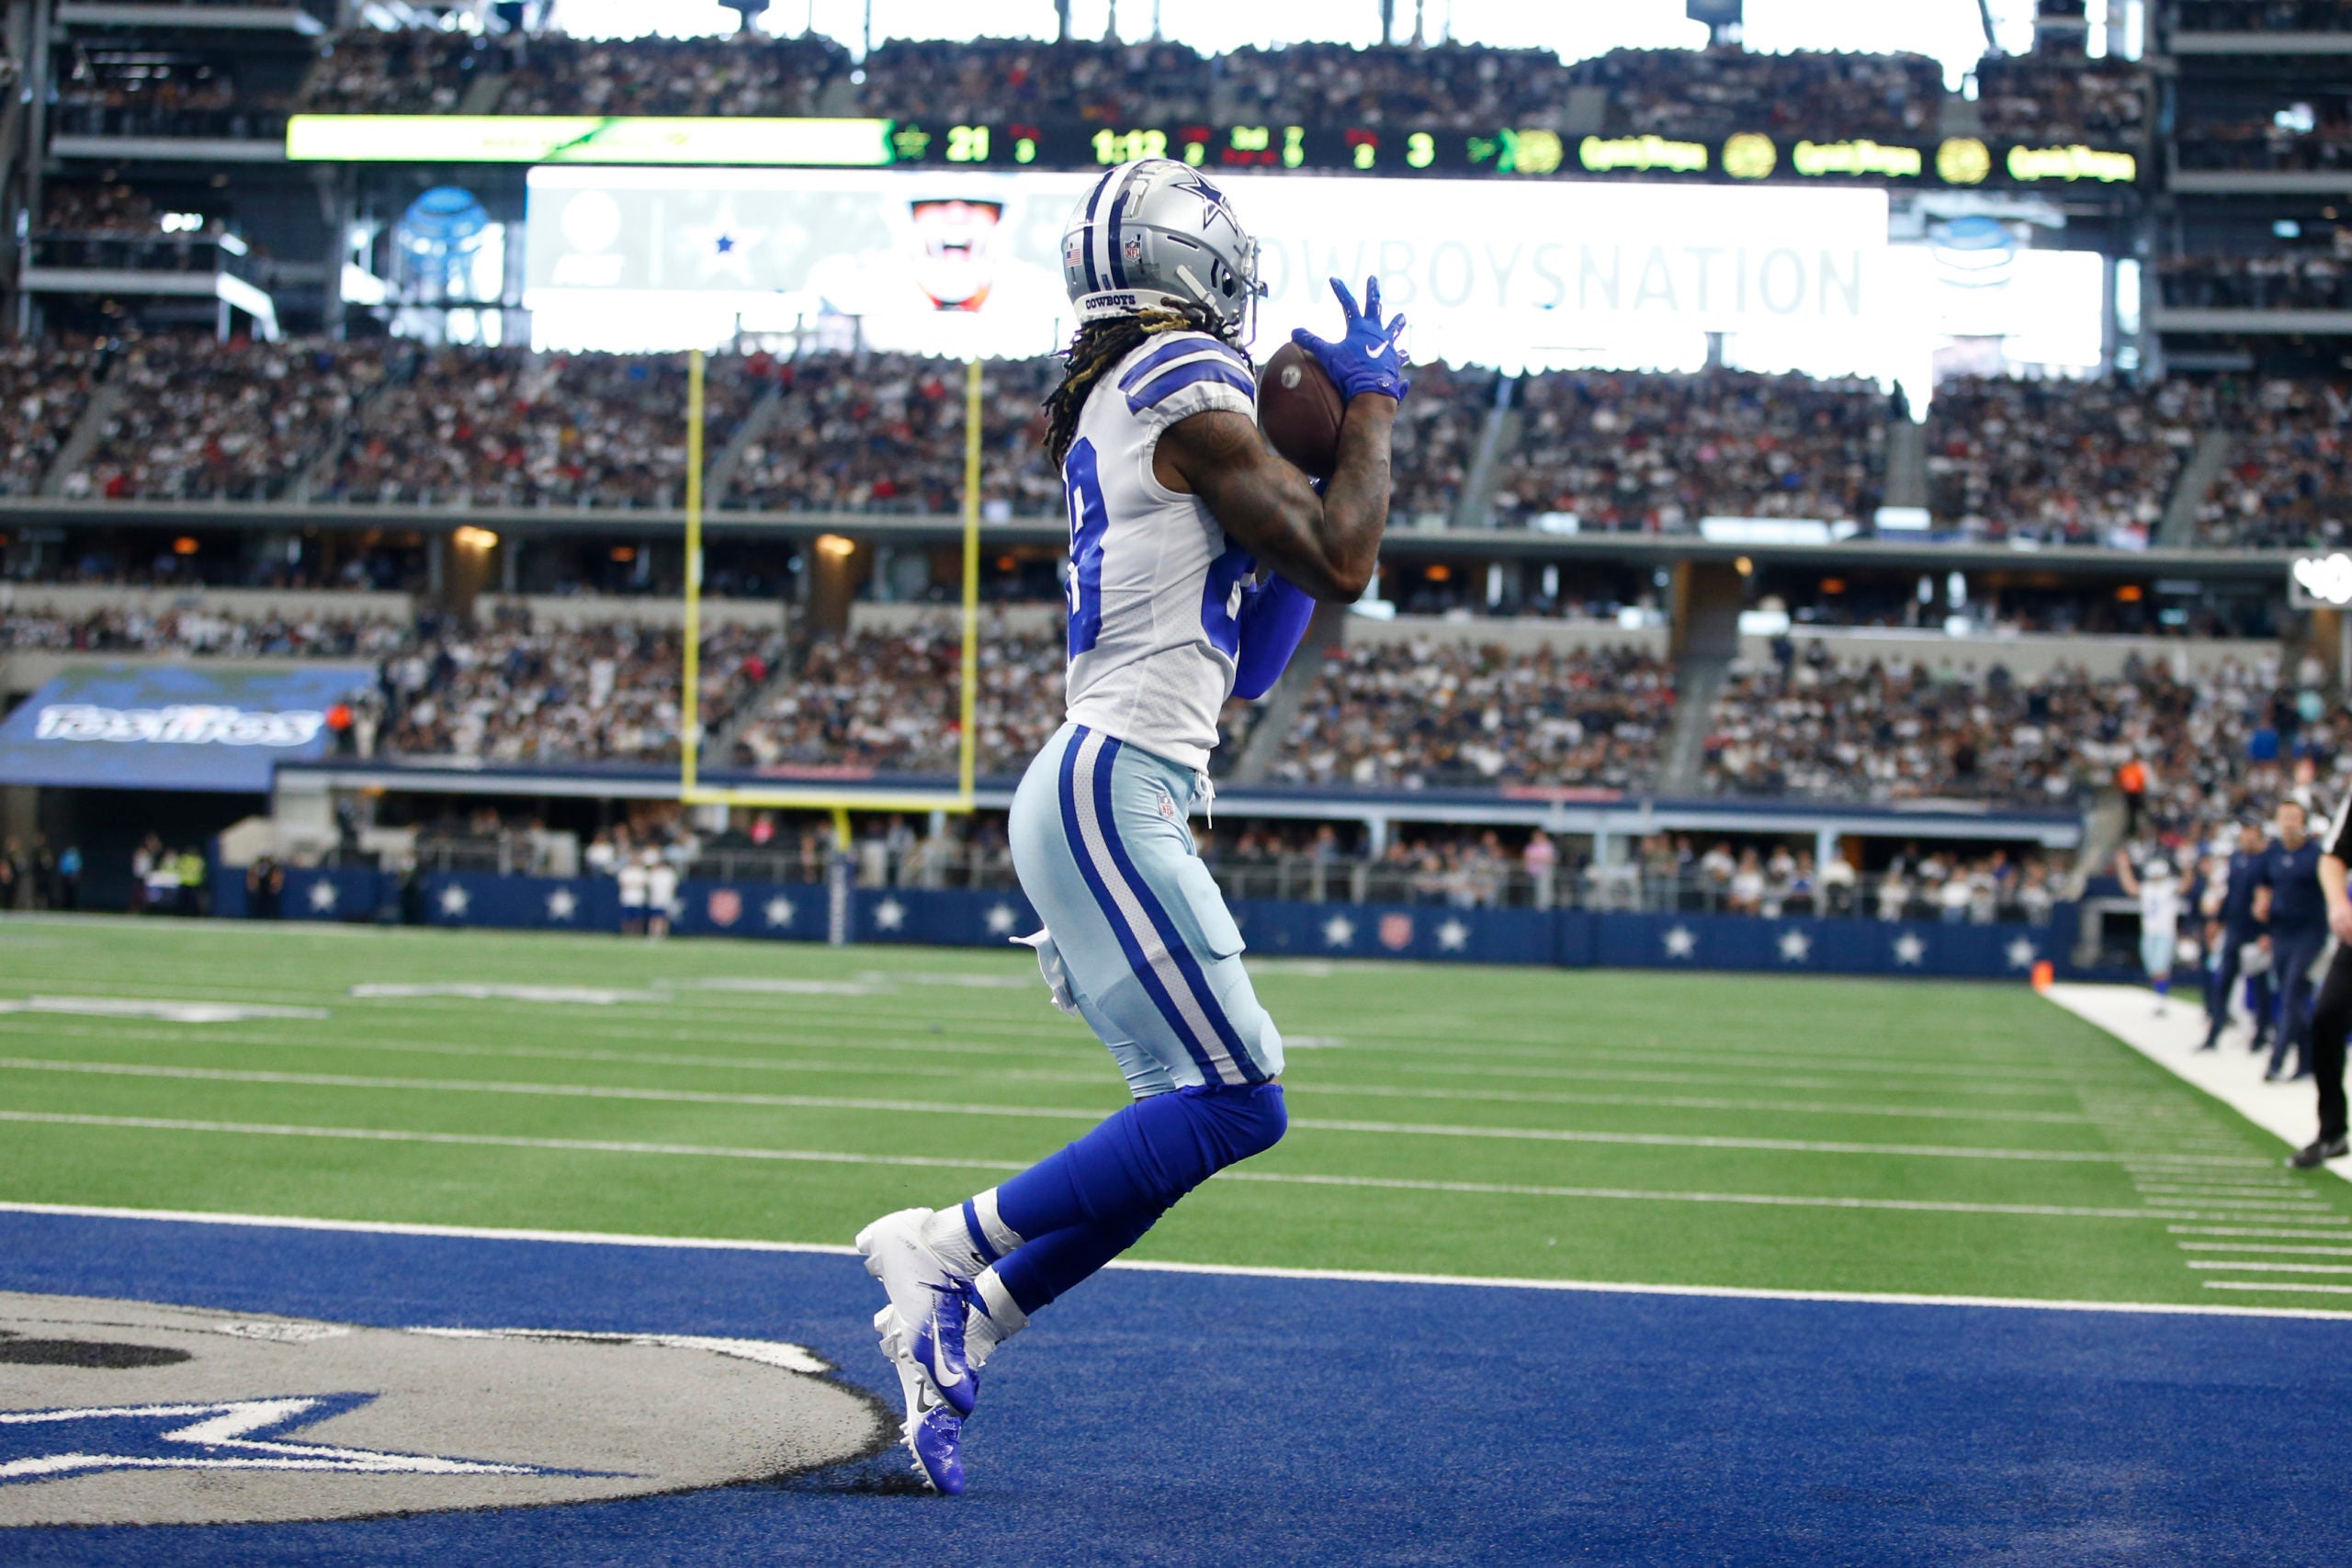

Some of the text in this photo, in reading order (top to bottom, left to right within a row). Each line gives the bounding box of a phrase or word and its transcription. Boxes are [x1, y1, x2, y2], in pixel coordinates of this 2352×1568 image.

[1125, 247, 1140, 258] NFL
[1251, 235, 1862, 317] OWBOYSNATION
[1085, 294, 1136, 310] COWBOYS
